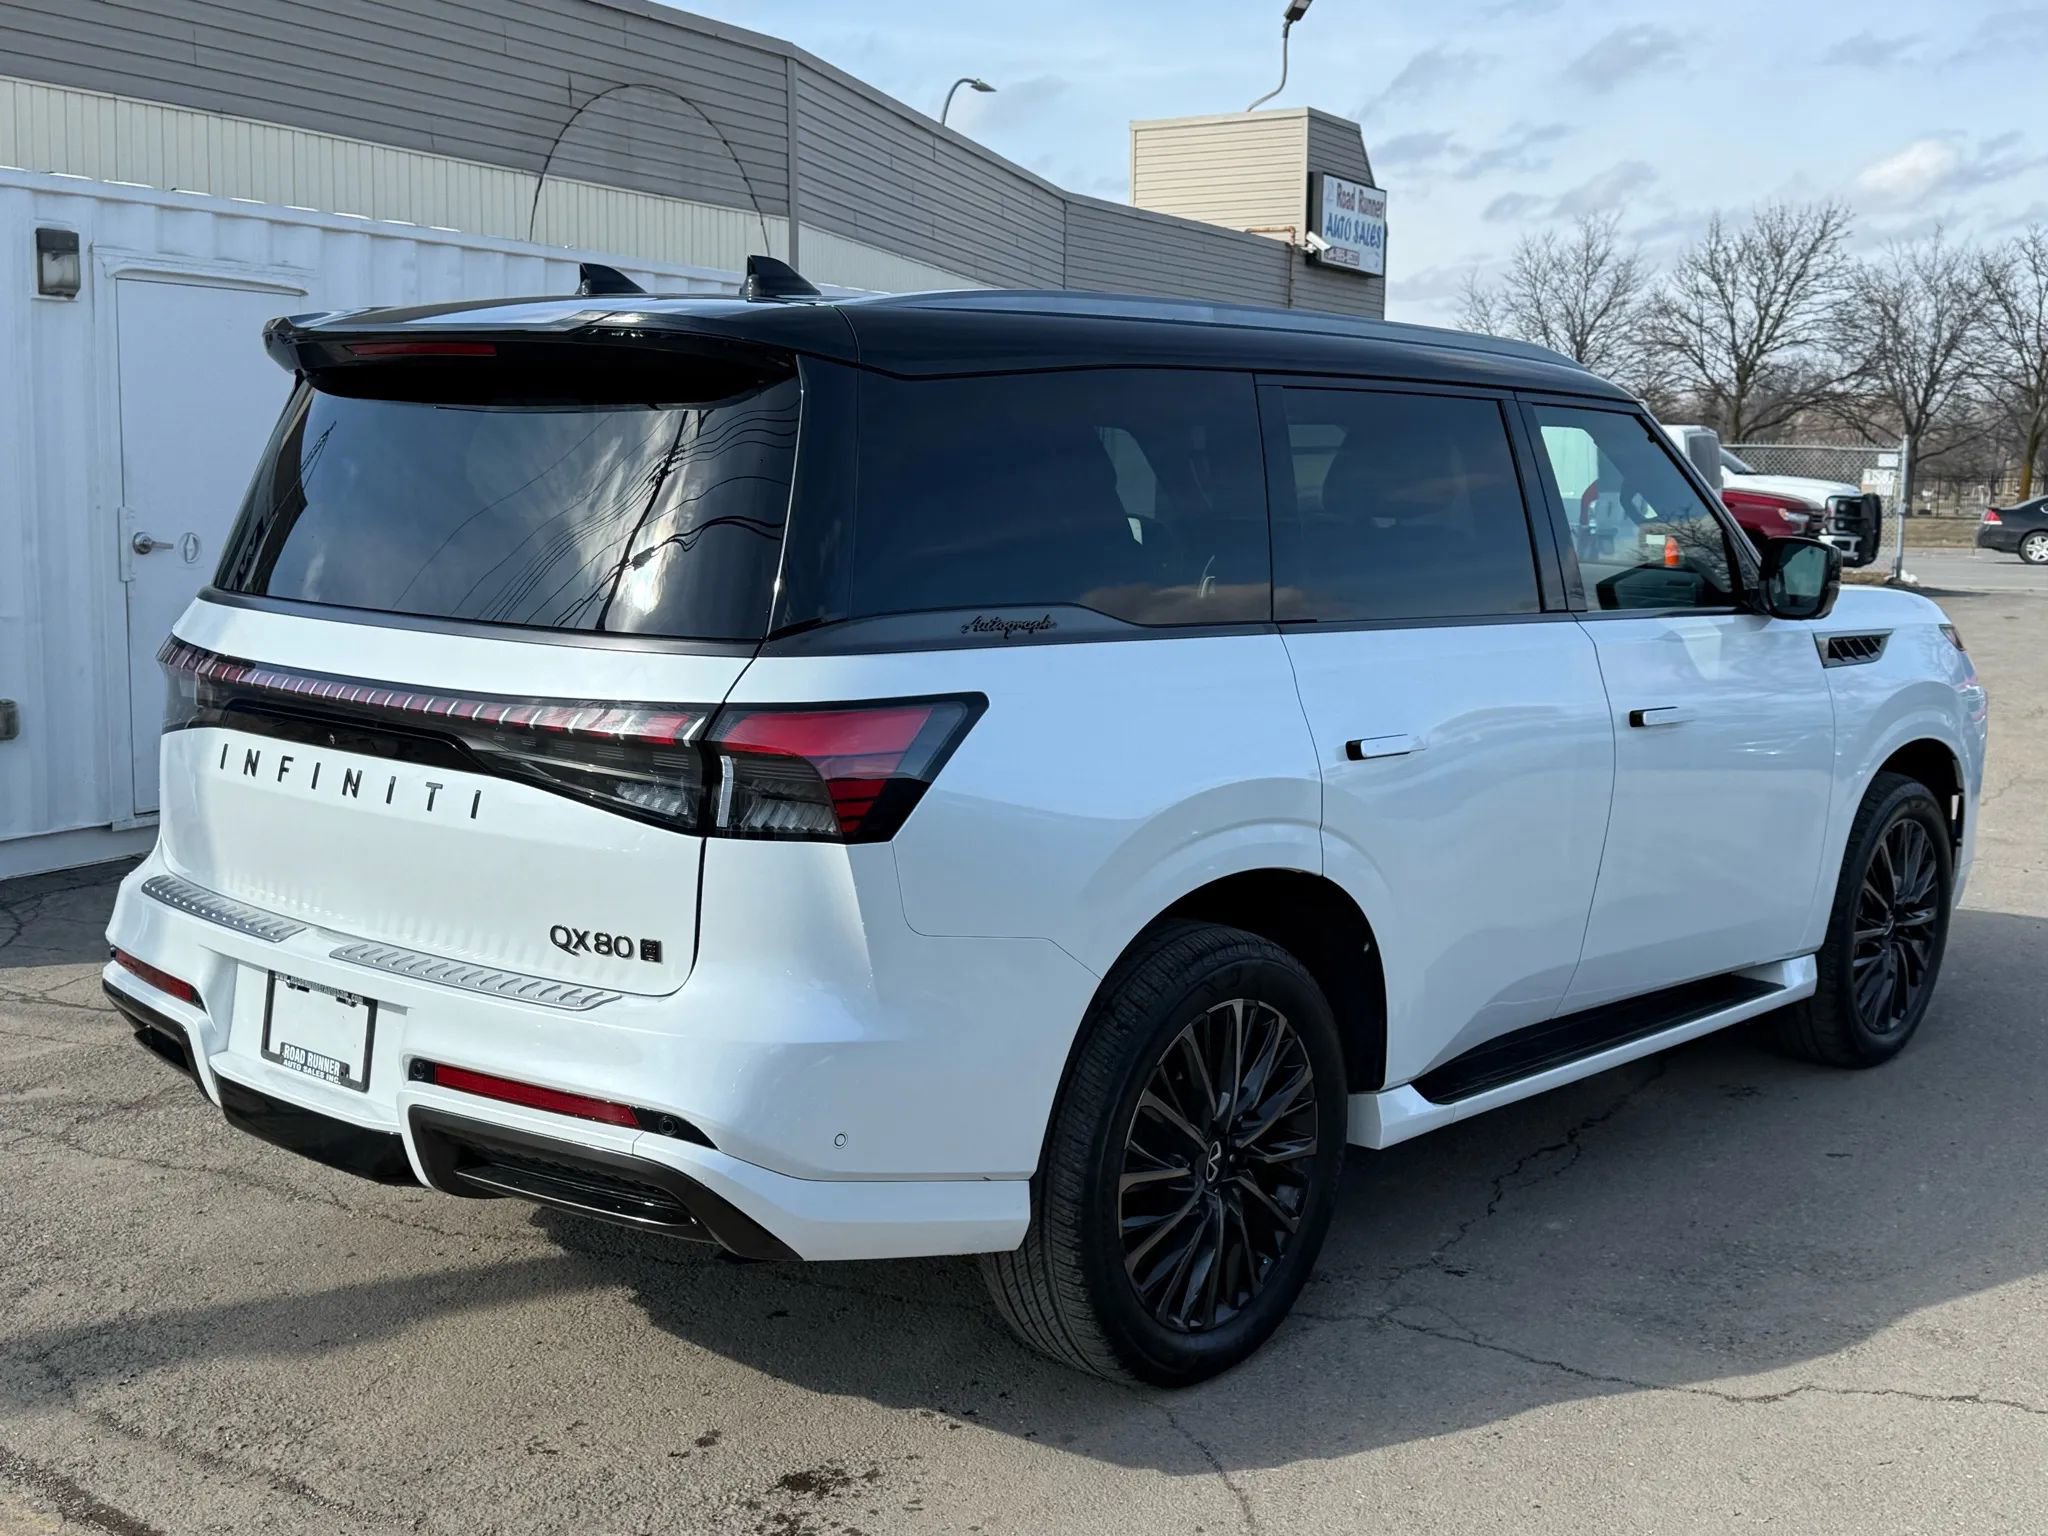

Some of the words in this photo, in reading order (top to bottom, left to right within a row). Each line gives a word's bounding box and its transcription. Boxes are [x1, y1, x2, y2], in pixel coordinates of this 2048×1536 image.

[1325, 212, 1352, 242] AUTO
[1353, 219, 1382, 249] SALES
[219, 743, 482, 820] INFINITI
[549, 924, 635, 959] QX80
[283, 1043, 306, 1065] ROAD
[307, 1050, 341, 1077] RUNNER
[283, 1059, 301, 1071] AUTO
[303, 1065, 325, 1079] SALES
[326, 1072, 342, 1085] INC.
